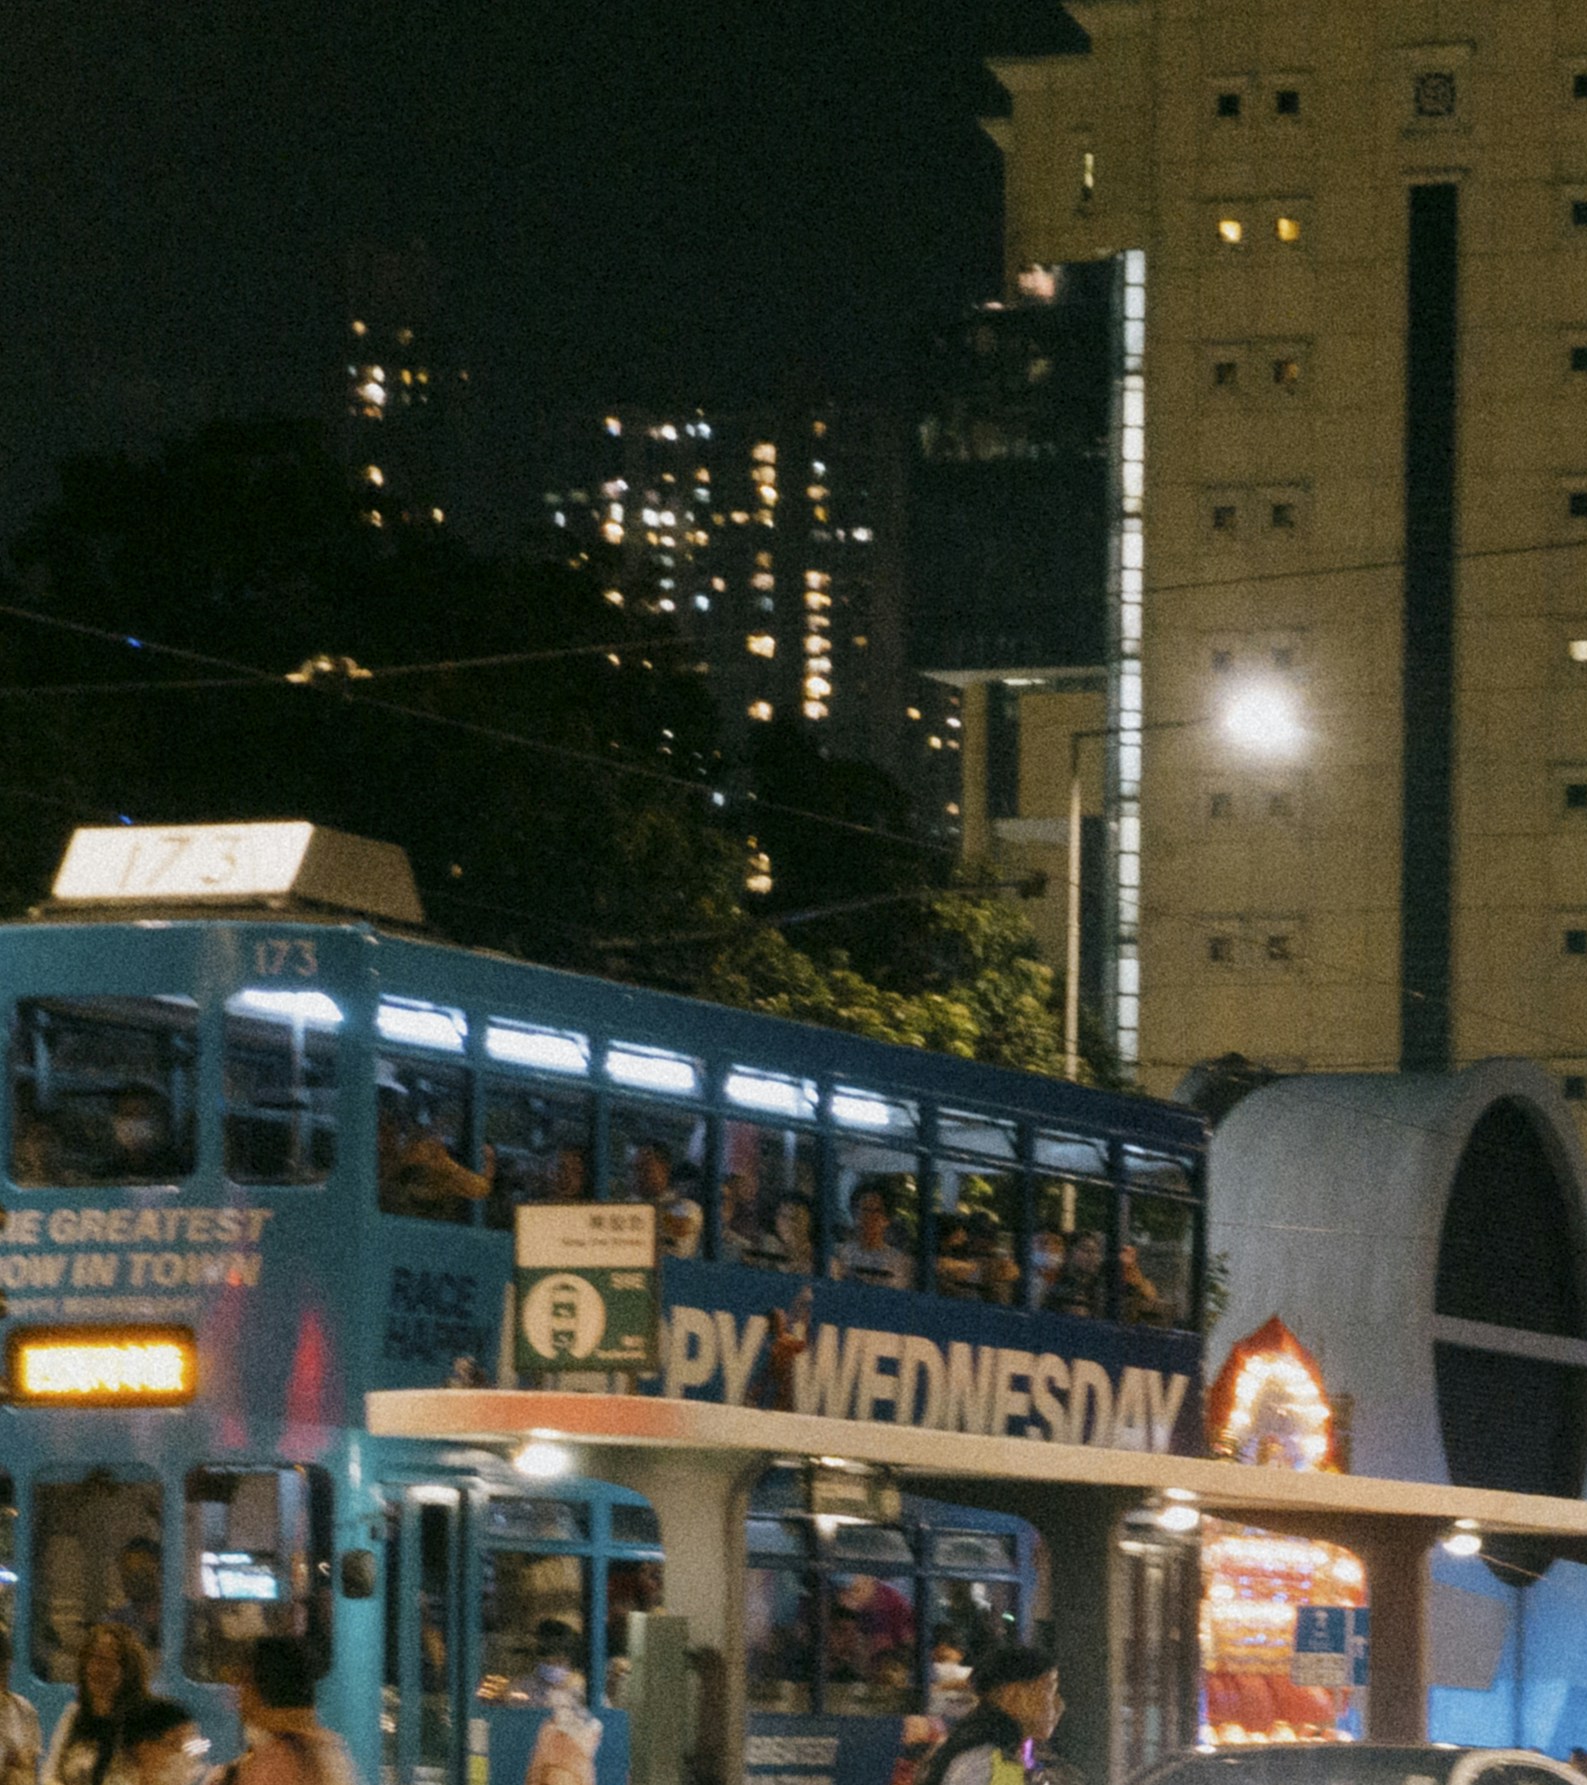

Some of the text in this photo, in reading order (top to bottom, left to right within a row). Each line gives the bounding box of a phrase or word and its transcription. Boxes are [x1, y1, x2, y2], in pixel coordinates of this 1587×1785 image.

[116, 835, 243, 890] 173
[256, 939, 318, 977] 173
[48, 1207, 274, 1244] GREATEST
[71, 1252, 119, 1287] IN
[128, 1252, 264, 1288] TOWN
[791, 1322, 1190, 1453] WEDNESDAY
